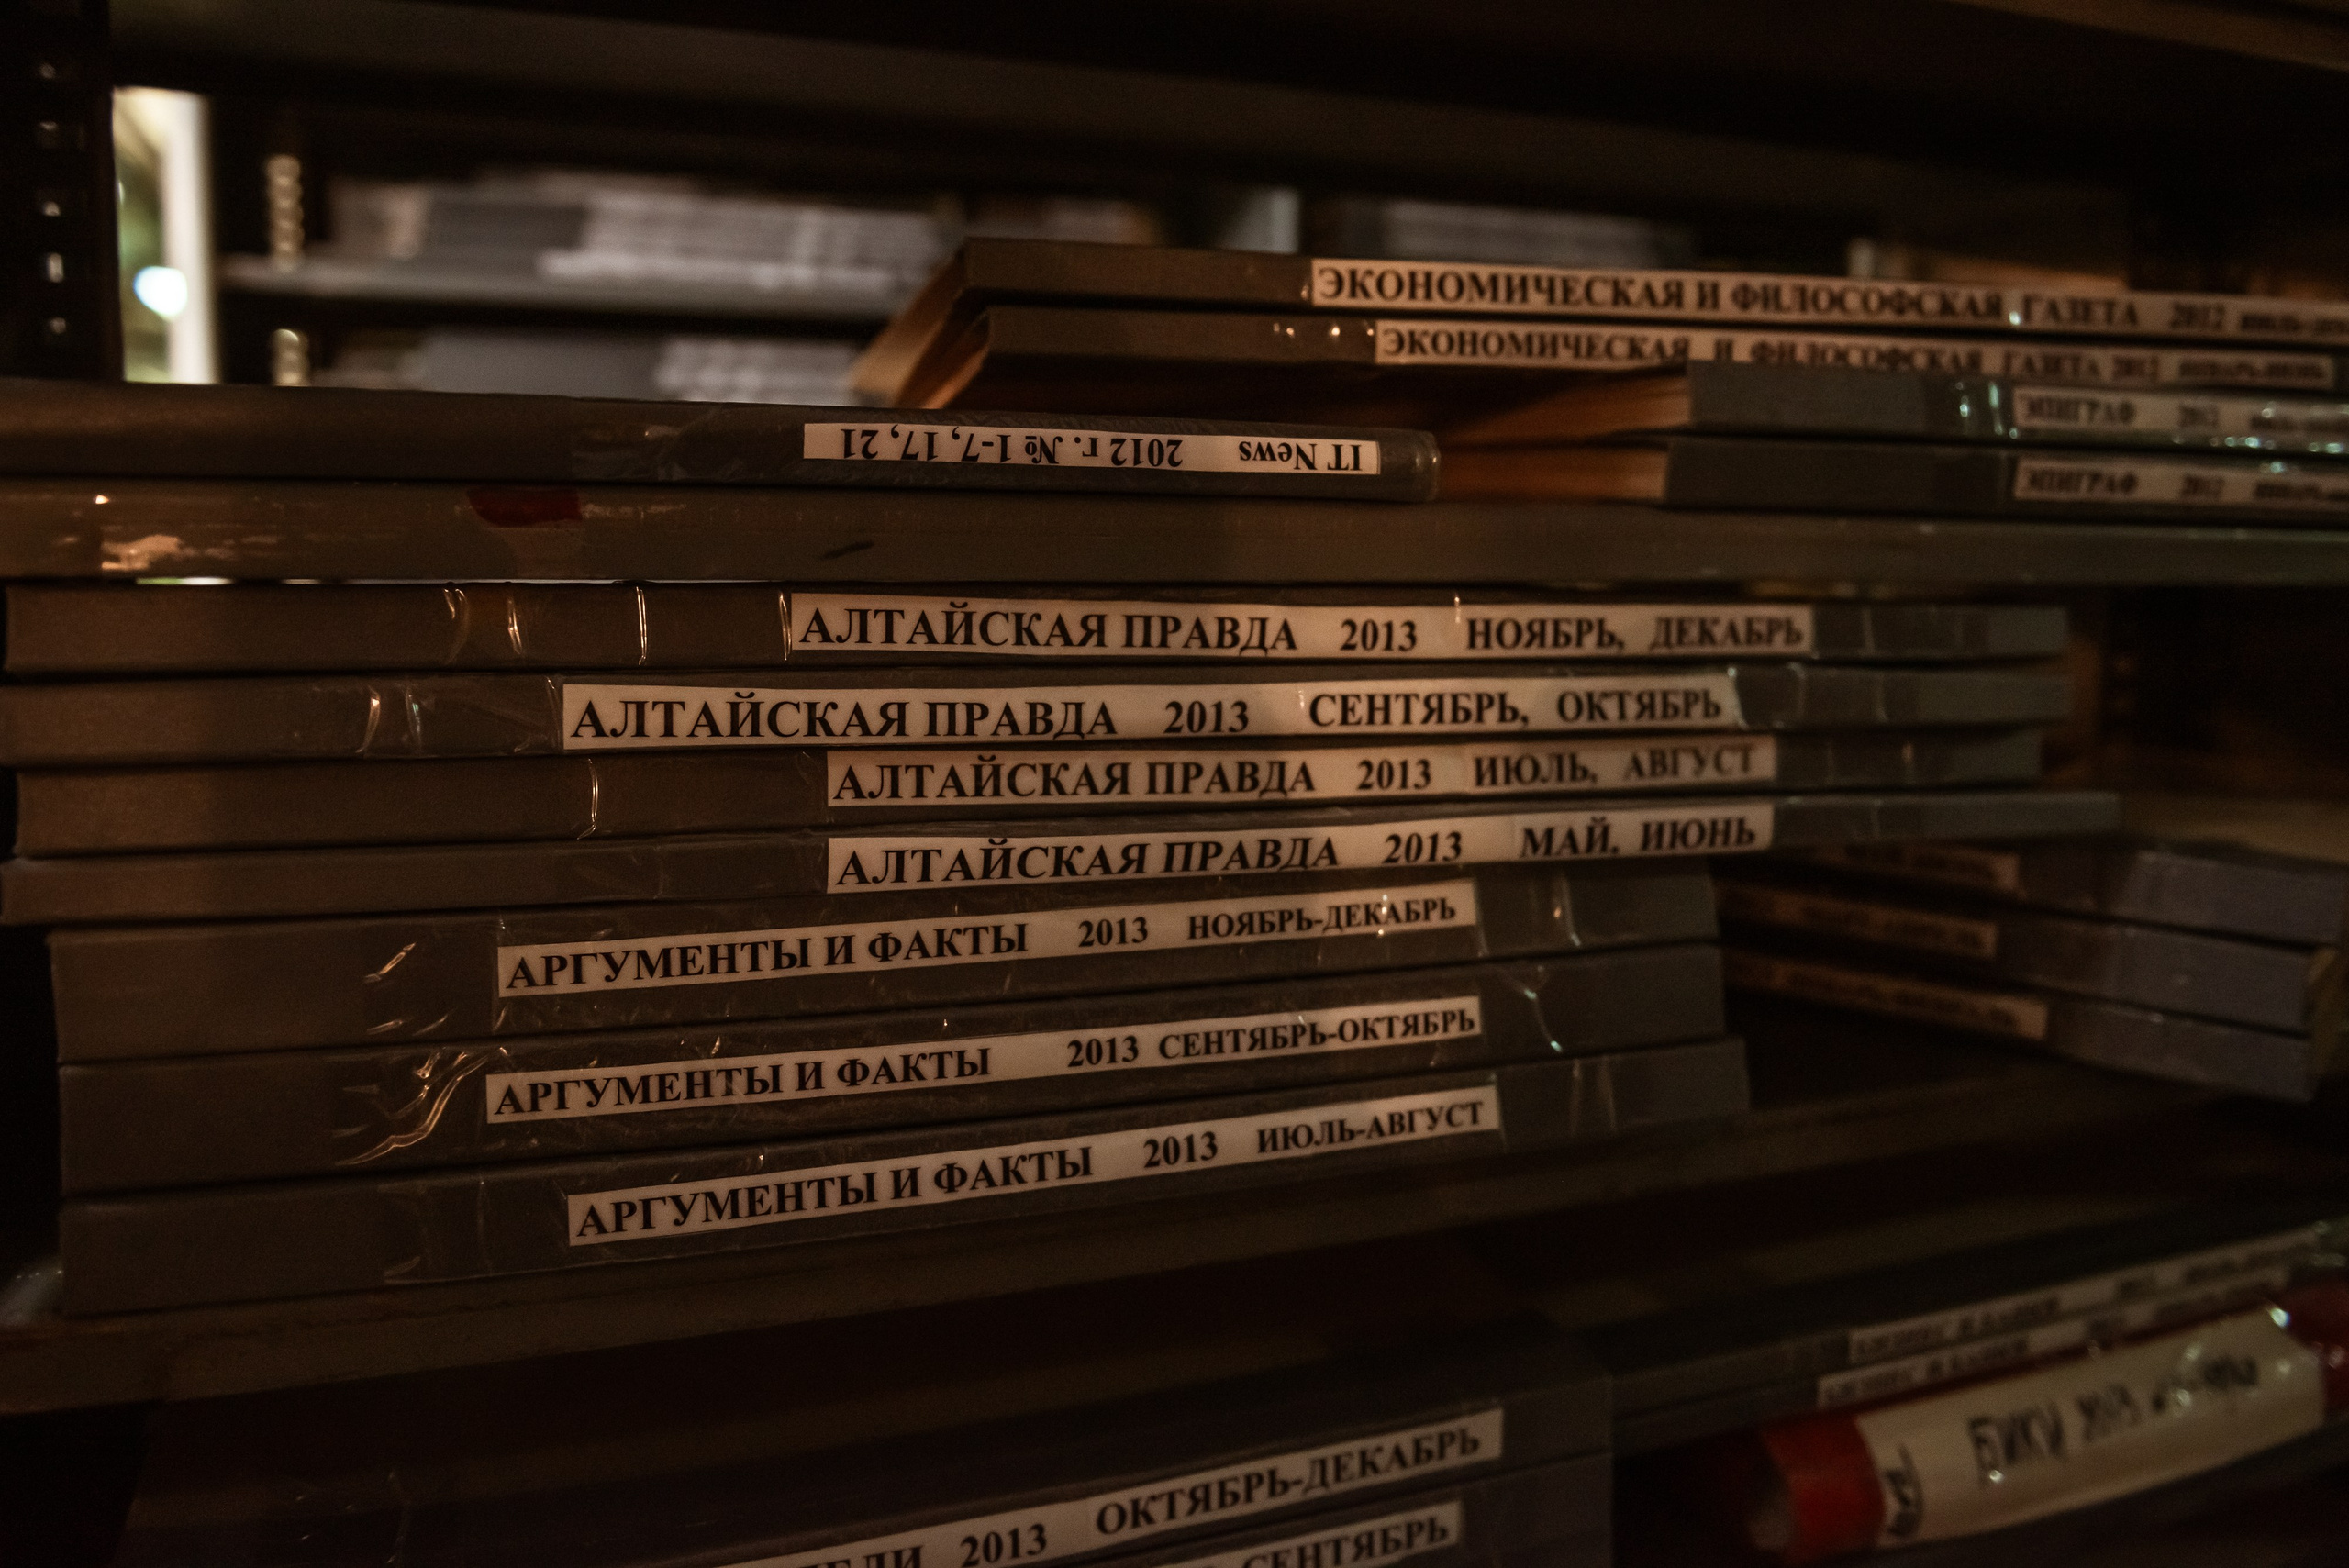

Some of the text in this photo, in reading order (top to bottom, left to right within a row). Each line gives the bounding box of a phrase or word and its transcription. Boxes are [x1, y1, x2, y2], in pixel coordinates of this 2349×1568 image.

[1318, 267, 1685, 310] ЭКОНОМИЧЕСКАЯ
[1697, 282, 1720, 311] И
[1730, 283, 2001, 319] ФИЛОСОФСКАЯ
[1383, 328, 1690, 361] ЭКОНОМИЧЕСКАЯ
[841, 428, 878, 459] 21
[1024, 434, 1061, 464] №
[1111, 438, 1184, 467] 2012
[1239, 440, 1318, 471] News
[1327, 443, 1363, 472] IT
[799, 601, 1803, 657] АЛТАЙСКАЯ ПРАВДА 2013 НОЯБРЬ, ДЕКАБРЬ
[570, 688, 1721, 740] АЛТАЙСКАЯ ПРАВДА 2013 СЕНТЯБРЬ, ОКТЯБРЬ
[831, 745, 1756, 800] АЛТАЙСКАЯ ПРАВДА 2013 ИЮЛЬ, АВГУСТ
[835, 837, 1149, 886] АЛТАЙСКАЯ
[1162, 836, 1340, 874] ПРАВДА
[1382, 831, 1464, 863] 2013
[1639, 817, 1757, 851] ИЮНЬ
[505, 896, 1457, 990] АРГУМЕНТЫ И ФАКТЫ 2013 НОЯБРЬ-ДЕКАБРЬ
[493, 1008, 1475, 1117] АРГУМЕНТЫ И ФАКТЫ 2013 СЕНТЯБРЬ-ОКТЯБРЬ
[575, 1101, 1486, 1238] АРГУМЕНТЫ И ФАКТЫ 2013 ИЮЛЬ-АВГУСТ
[960, 1523, 1049, 1568] 2013
[1095, 1428, 1481, 1537] ОКТЯБРЬ-ДЕКАБРЬ
